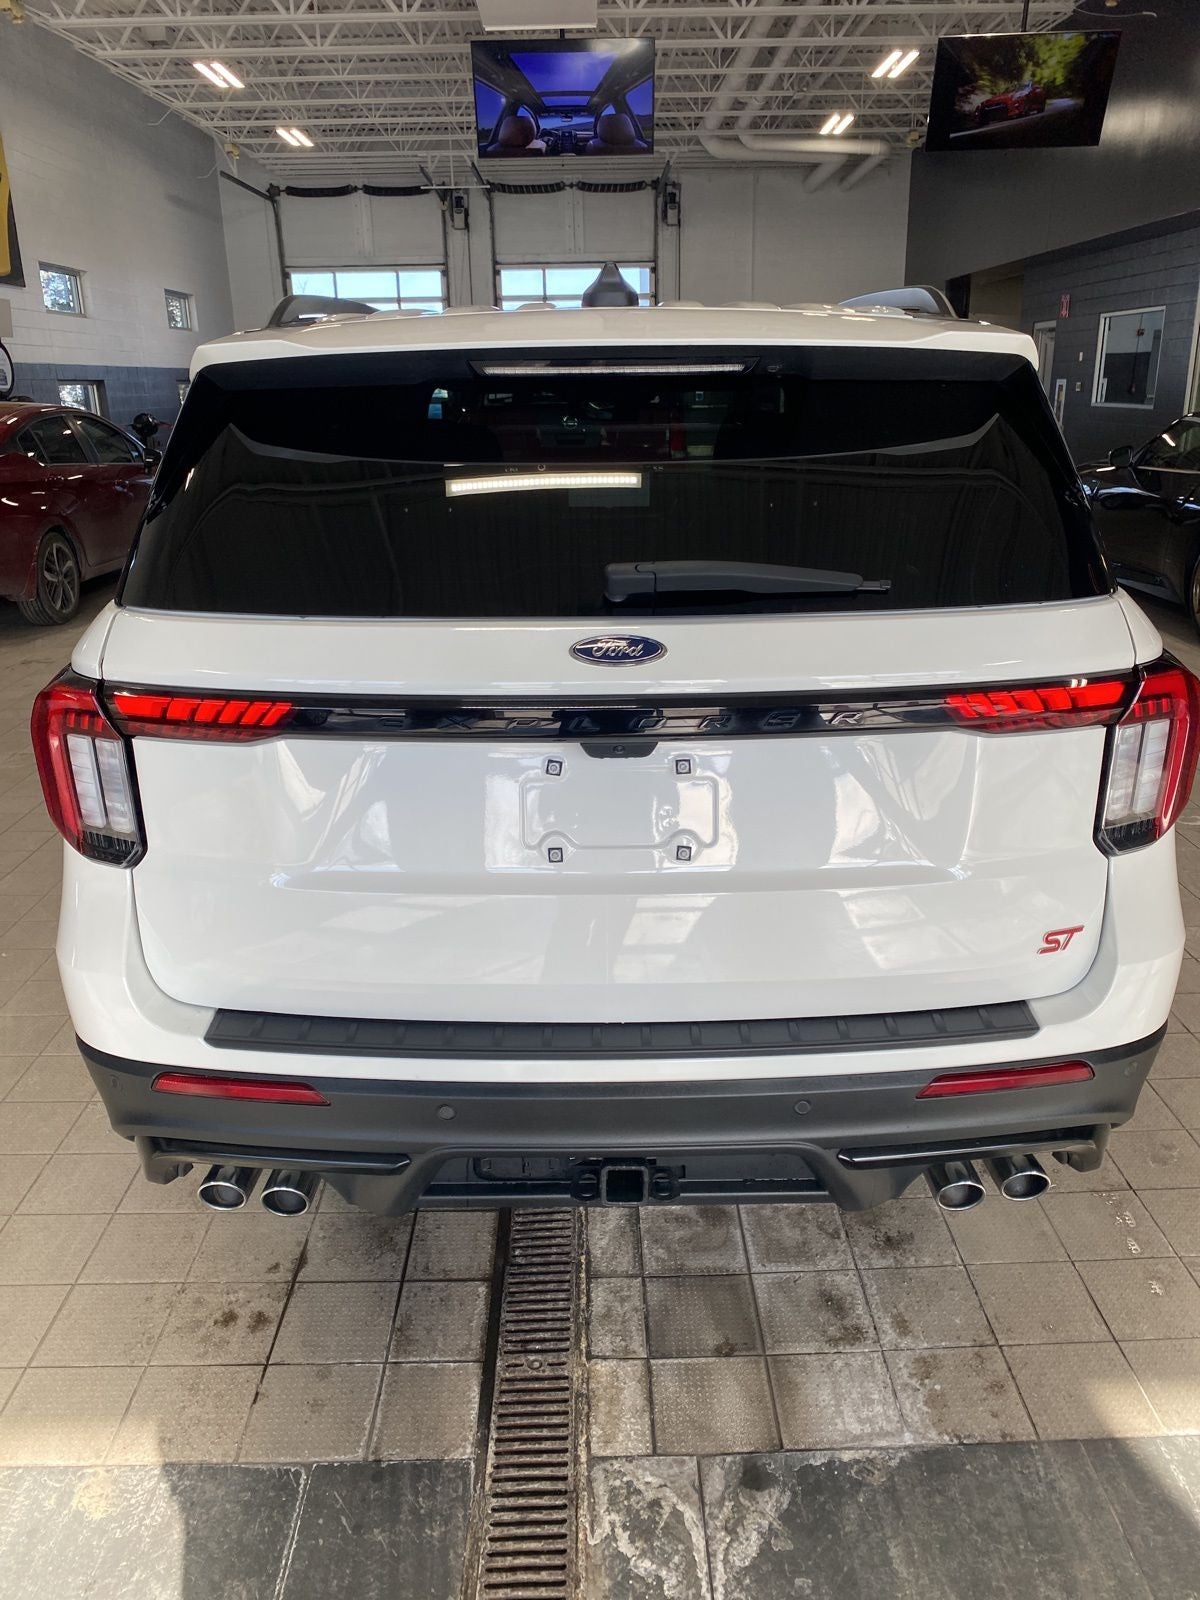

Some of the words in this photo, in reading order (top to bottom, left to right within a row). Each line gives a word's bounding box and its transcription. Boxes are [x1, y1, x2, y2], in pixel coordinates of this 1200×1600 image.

[584, 637, 646, 657] Ford
[375, 709, 866, 733] EXPLORER
[1036, 924, 1085, 955] ST
